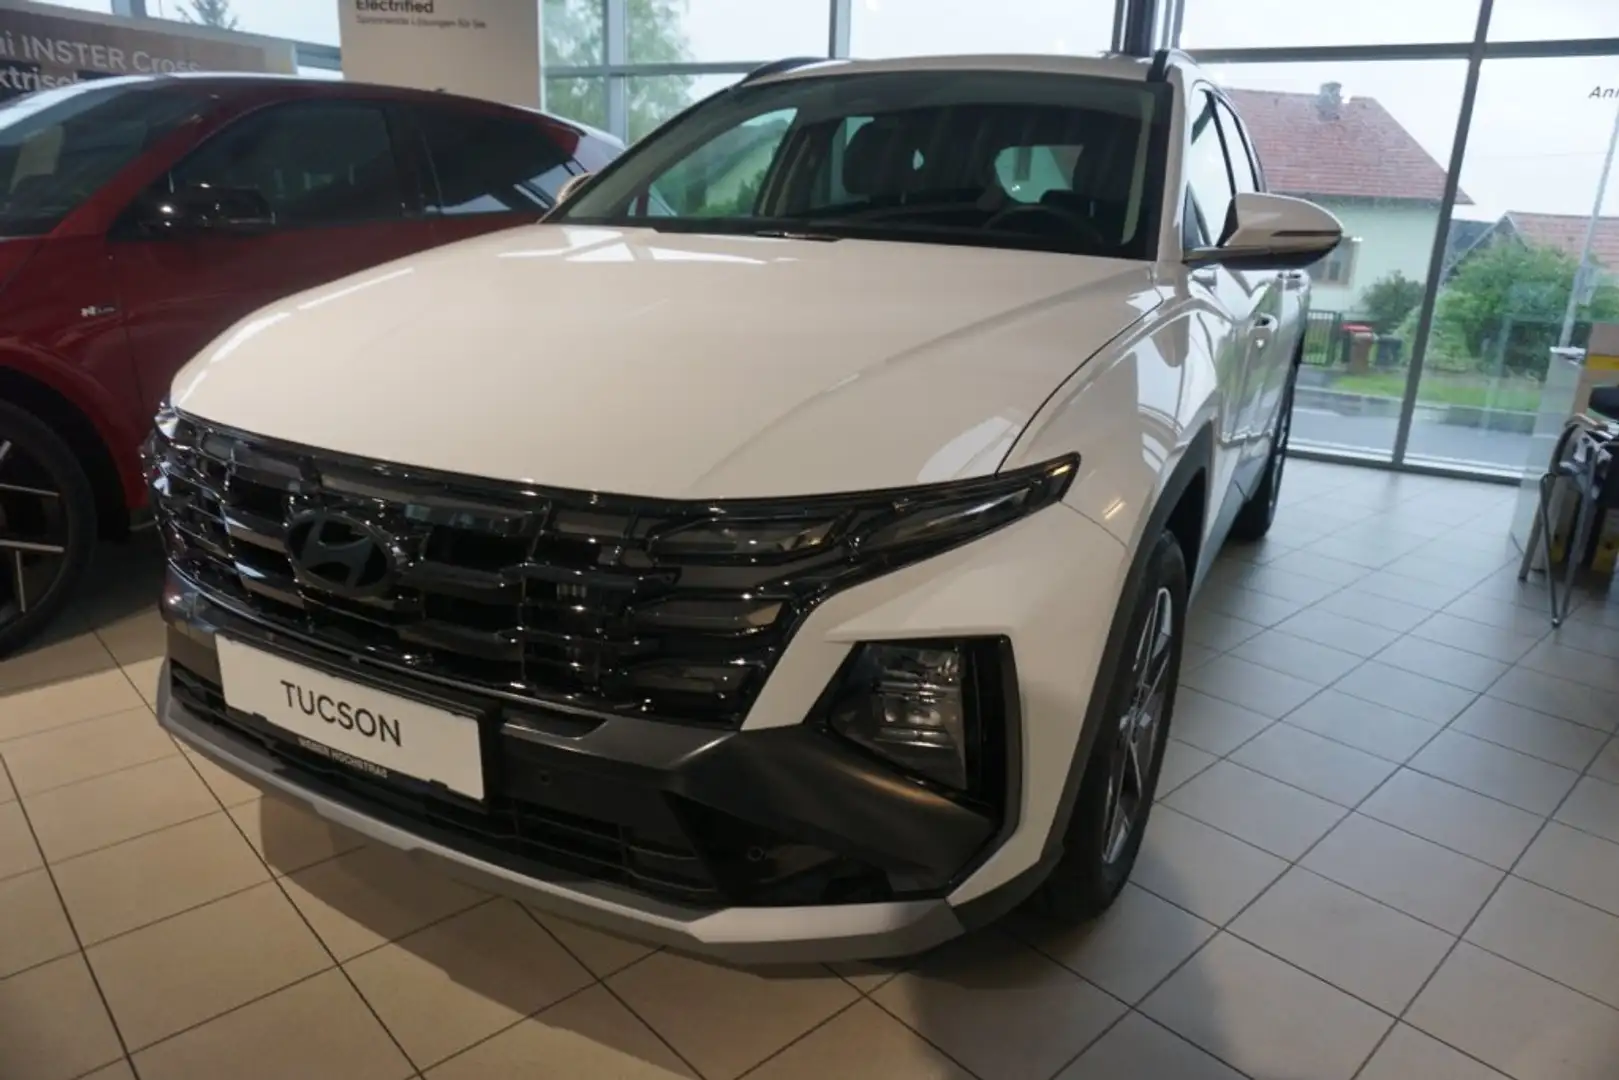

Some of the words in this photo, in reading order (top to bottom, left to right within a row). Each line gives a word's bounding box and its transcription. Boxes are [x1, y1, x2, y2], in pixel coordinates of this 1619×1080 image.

[356, 0, 434, 13] Electrified
[22, 35, 126, 71] INSTER
[132, 51, 201, 73] Cross
[280, 679, 402, 748] TUCSON
